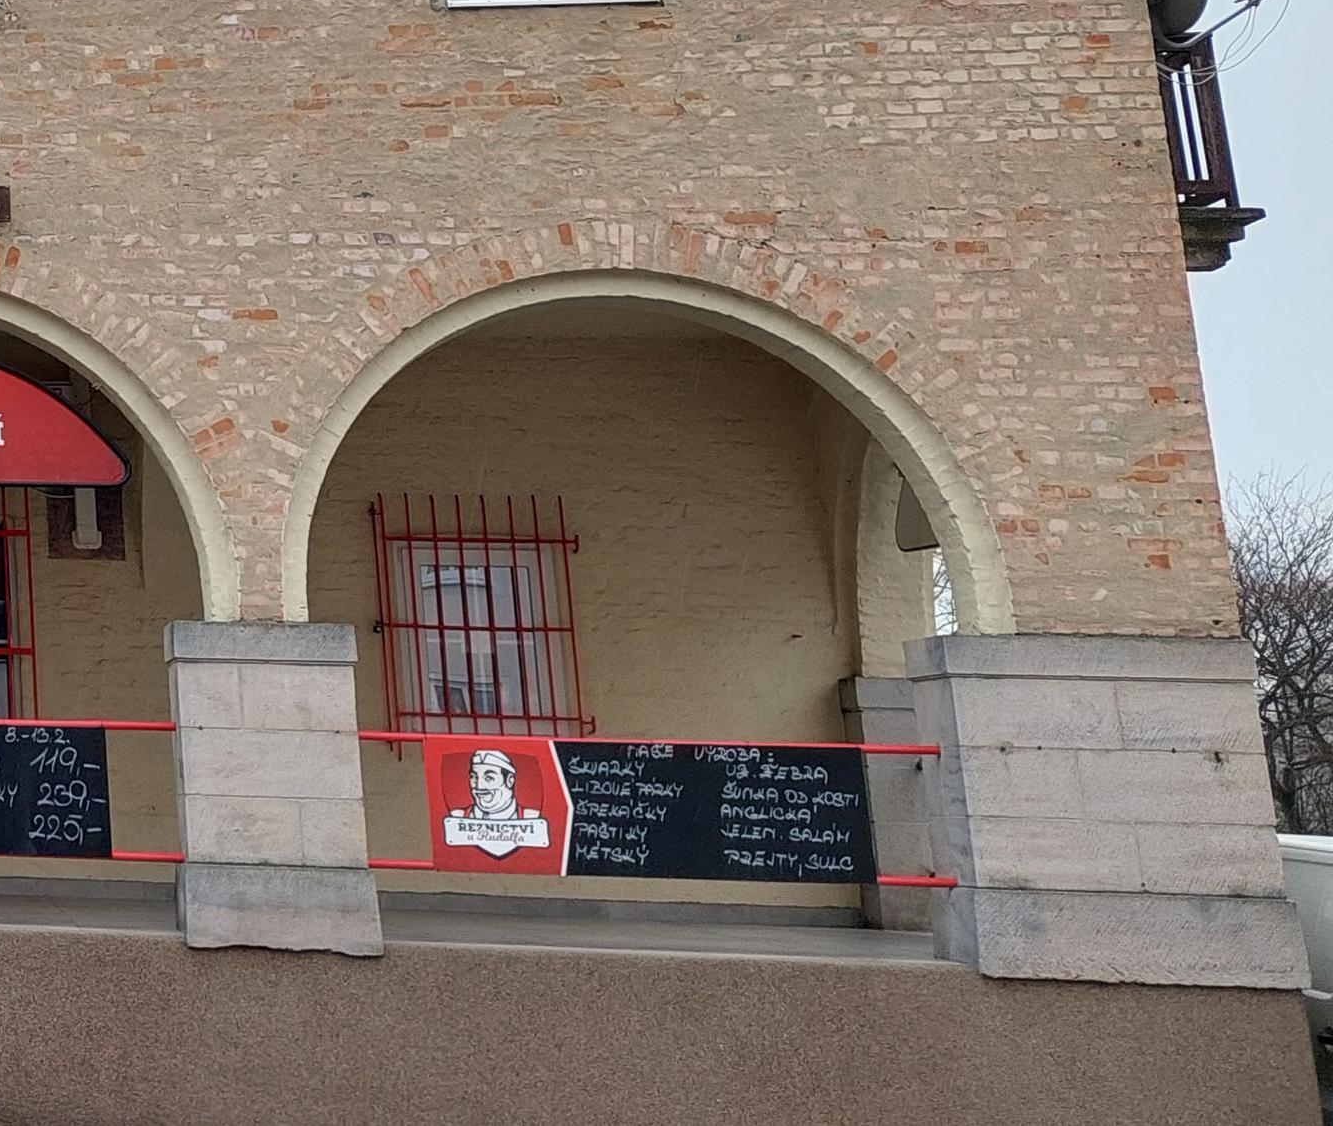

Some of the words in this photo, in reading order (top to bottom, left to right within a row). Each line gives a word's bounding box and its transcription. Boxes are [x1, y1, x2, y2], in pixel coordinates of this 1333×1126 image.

[627, 744, 674, 759] NAŠE
[721, 780, 779, 803] ŠUNKA
[785, 789, 808, 804] OD
[812, 791, 859, 807] KOSTI
[458, 819, 535, 834] ŘEZNICTVÍ
[789, 822, 851, 844] SALÁM
[476, 831, 525, 844] Rudolfa
